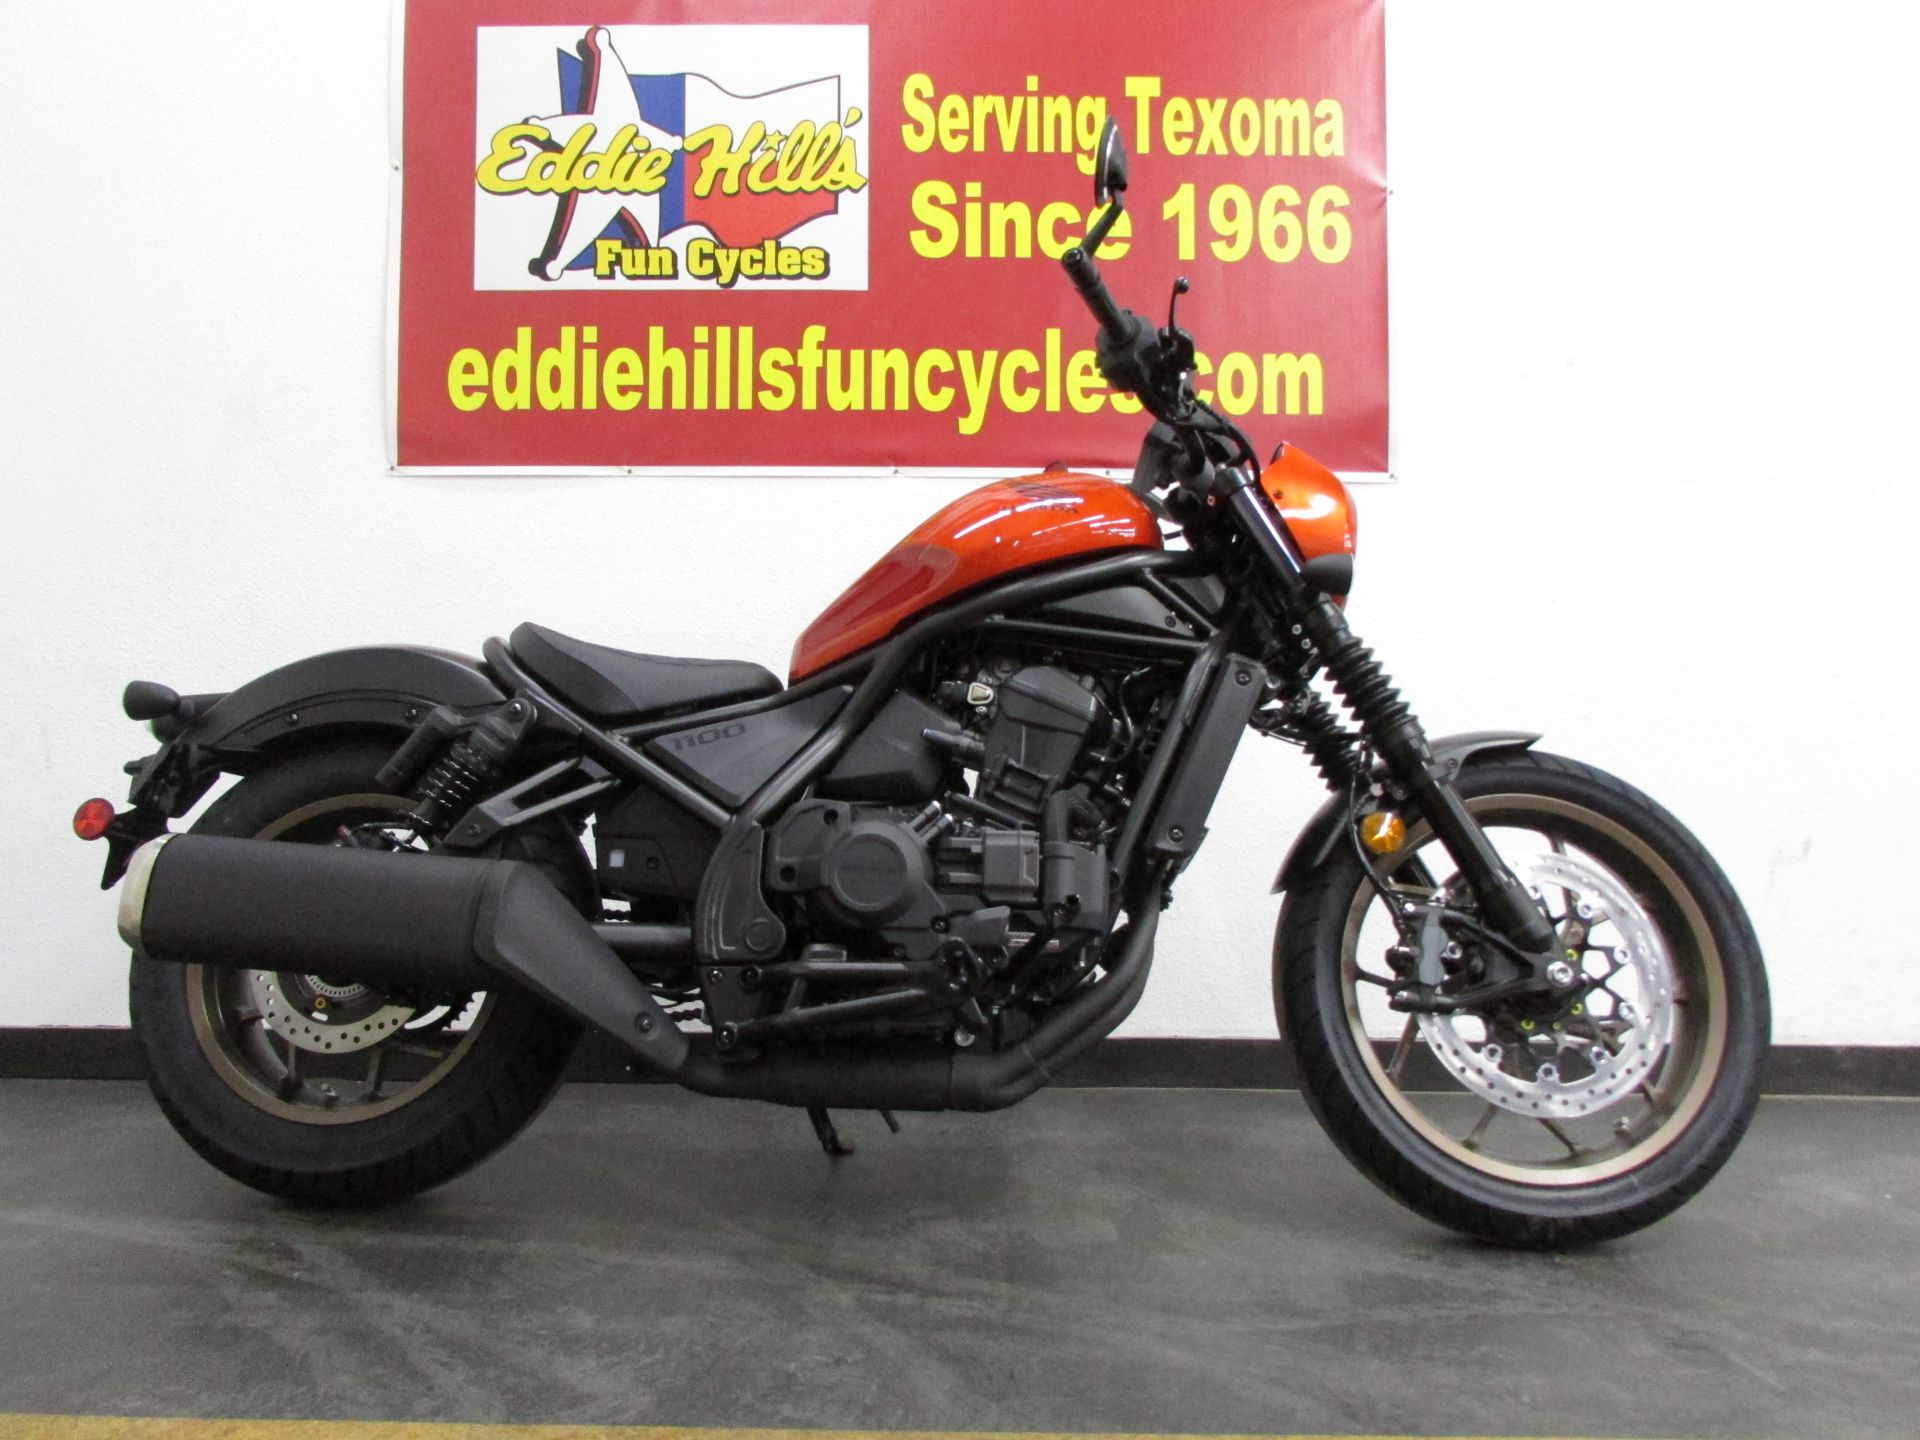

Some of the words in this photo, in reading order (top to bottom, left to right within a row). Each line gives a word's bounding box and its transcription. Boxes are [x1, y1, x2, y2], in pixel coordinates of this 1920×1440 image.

[476, 123, 674, 195] Eddie
[683, 106, 869, 198] Hill's
[901, 73, 1107, 175] Serving
[1125, 76, 1346, 157] Texoma
[594, 239, 679, 280] Fun
[685, 239, 830, 288] Cycles
[909, 180, 1133, 260] Since
[1162, 183, 1352, 263] 1966
[447, 325, 1324, 436] eddiehillsfuncycleom
[672, 722, 746, 750] 1100
